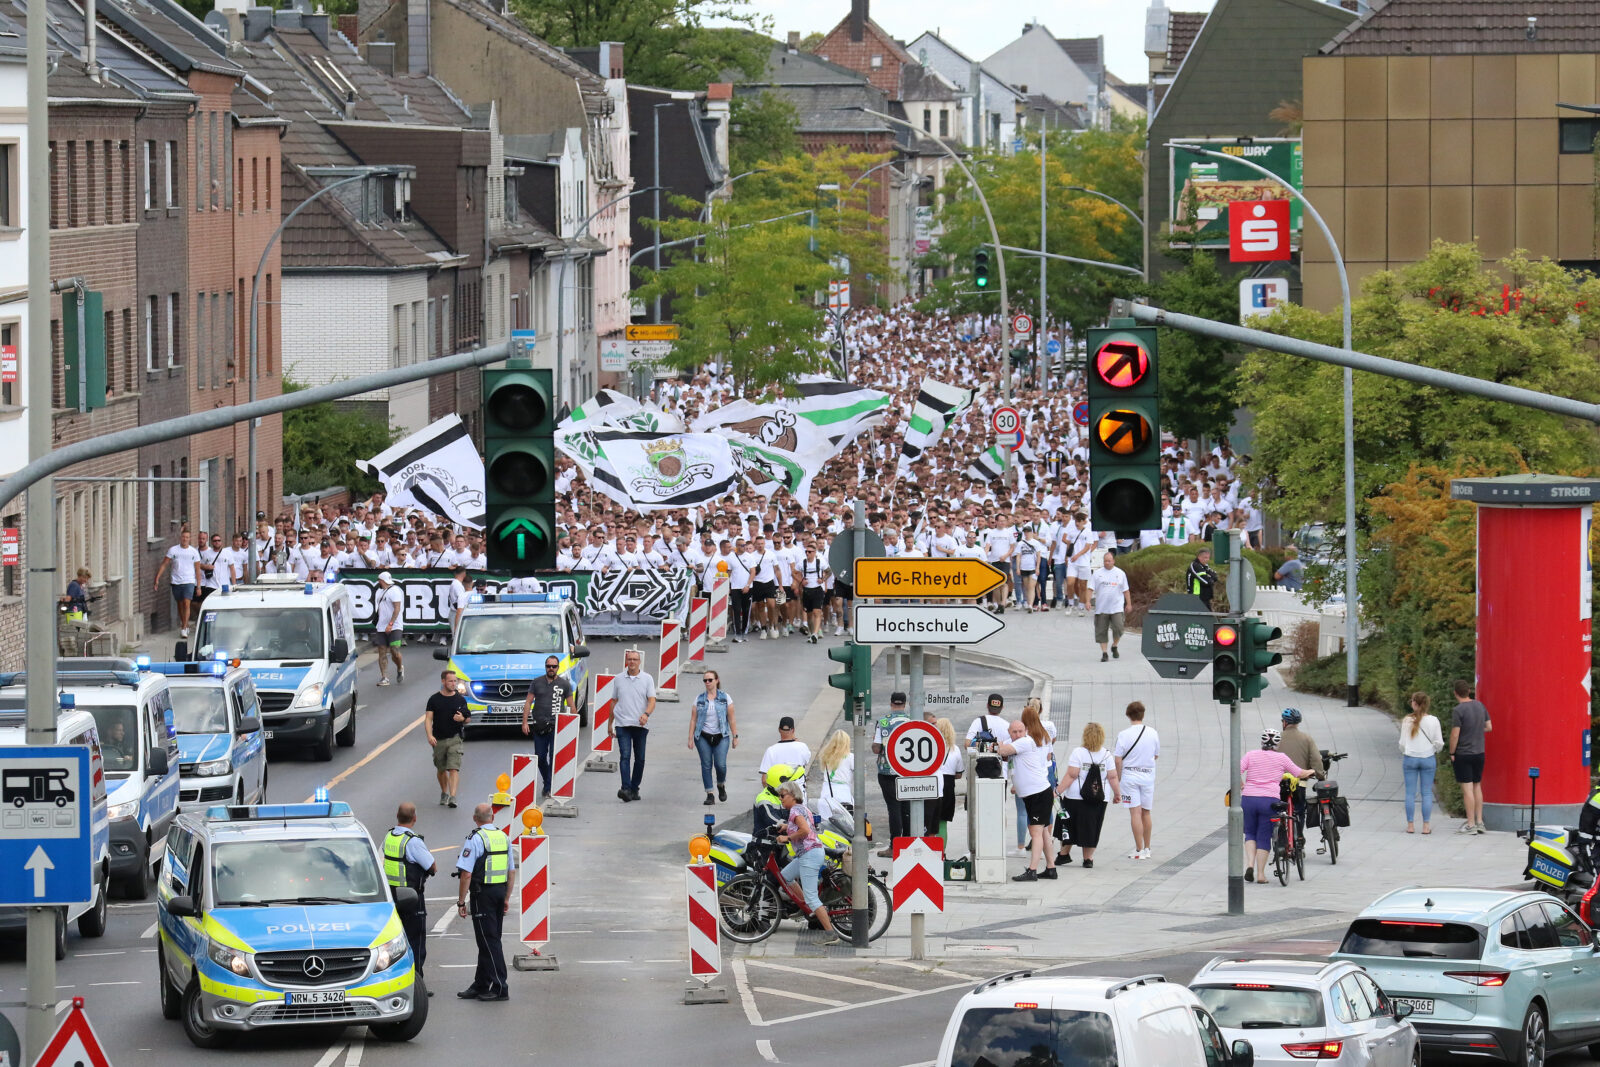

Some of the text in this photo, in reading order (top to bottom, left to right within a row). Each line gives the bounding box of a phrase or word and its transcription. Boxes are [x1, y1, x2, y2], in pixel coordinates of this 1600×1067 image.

[1221, 146, 1272, 156] SUBWAY
[1017, 320, 1029, 329] 30
[998, 415, 1015, 428] 30
[1551, 486, 1591, 498] STRÖER
[877, 571, 967, 589] MG-Rheydt
[876, 618, 969, 632] Hochschule
[1156, 632, 1180, 643] ULTRA
[480, 663, 533, 671] POLIZEI
[250, 672, 284, 681] LIZEI
[899, 736, 933, 763] 30
[900, 784, 935, 793] Lärmschutz
[1535, 861, 1565, 880] POLIZEI
[266, 922, 351, 935] POLIZEI
[291, 992, 344, 1003] NRW 5 3426
